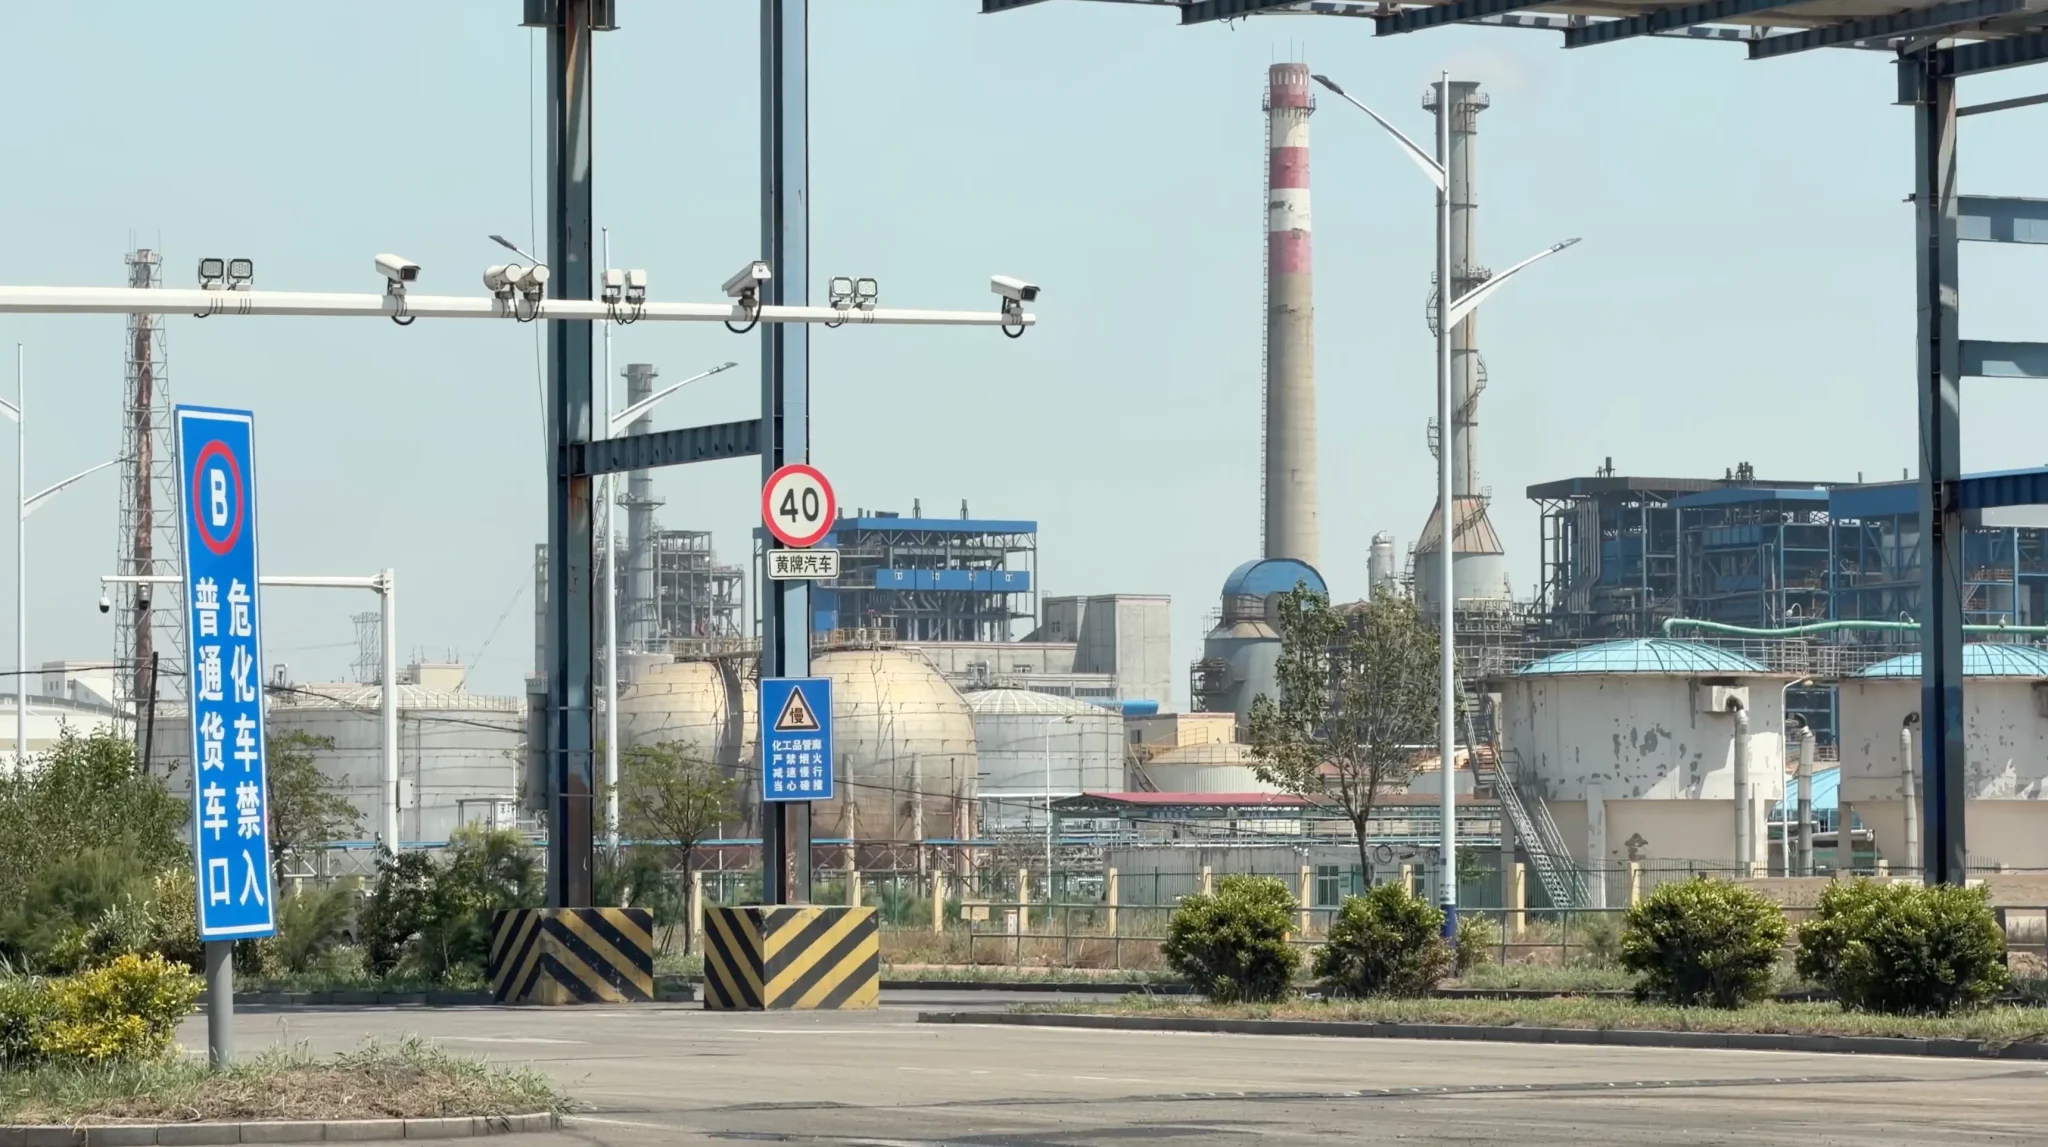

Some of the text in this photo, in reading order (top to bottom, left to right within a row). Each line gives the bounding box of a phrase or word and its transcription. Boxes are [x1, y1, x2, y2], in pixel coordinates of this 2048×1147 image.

[210, 468, 228, 527] B
[780, 487, 819, 523] 40
[775, 555, 832, 573] 黄牌汽车
[789, 707, 804, 724] 慢
[195, 576, 231, 907] 普通货车口
[227, 578, 265, 907] 危化车禁入
[772, 739, 822, 752] 化工品管廊
[772, 753, 822, 765] 严禁烟火
[772, 766, 823, 779] 减速慢行
[773, 780, 823, 792] 当心碰撞
